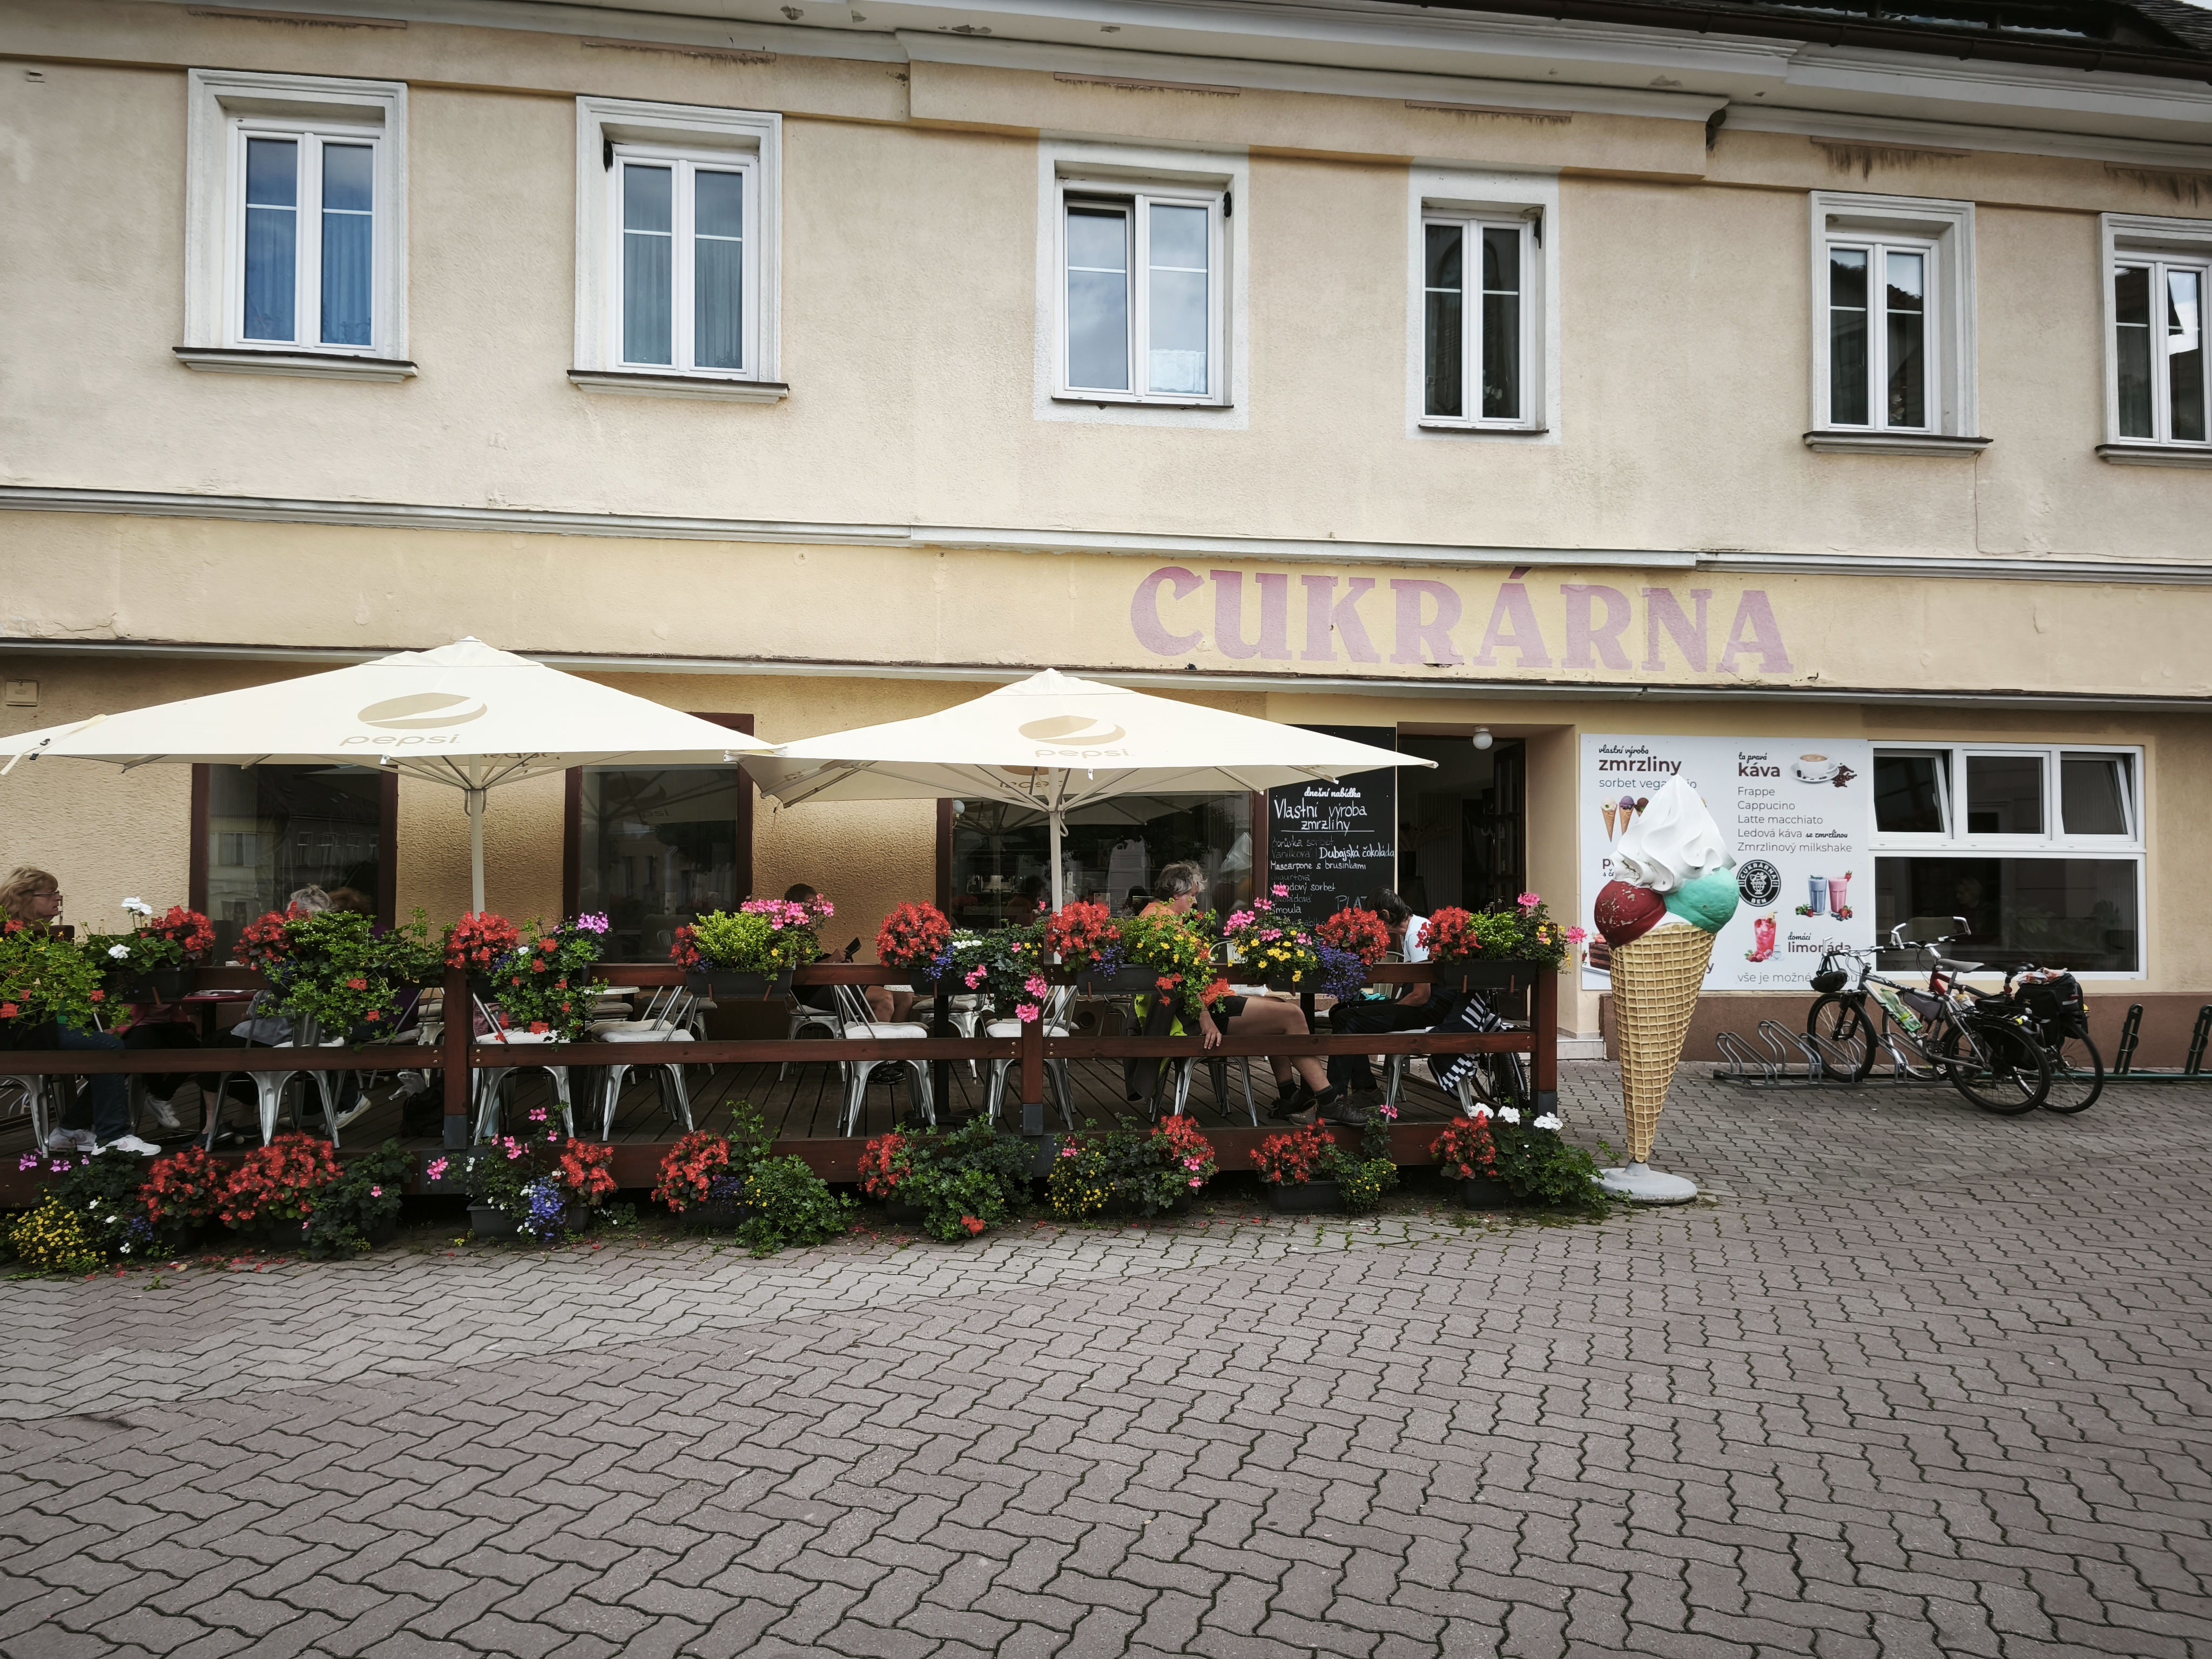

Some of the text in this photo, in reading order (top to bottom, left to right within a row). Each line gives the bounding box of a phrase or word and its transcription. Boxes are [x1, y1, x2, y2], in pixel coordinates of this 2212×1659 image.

[1130, 566, 1794, 674] CUKRÁRNA
[339, 734, 460, 747] pepsi
[1035, 749, 1129, 759] pepsi
[1599, 744, 1649, 758] vlastní výroba
[1738, 752, 1767, 764] ta pravá
[1599, 756, 1682, 776] zmrzliny
[1738, 762, 1780, 777] káva
[1599, 778, 1636, 788] sorbet
[1640, 780, 1667, 791] vega
[1304, 786, 1360, 798] dnešní nabídka
[1738, 786, 1775, 798] Frappe
[1274, 798, 1367, 819] Vlastní výroba
[1737, 800, 1795, 811] Cappucino
[1738, 815, 1823, 824] Latte macchiato
[1301, 817, 1350, 836] zmrzliny
[1738, 828, 1775, 838] Ledová
[1779, 828, 1802, 838] káva
[1815, 829, 1848, 838] zmrzlinou
[1307, 835, 1334, 846] sorbet
[1271, 848, 1313, 859] Vanilková
[1319, 842, 1394, 861] Dubajská čokoláda
[1737, 842, 1852, 854] Zmrzlinový milkshake
[1270, 860, 1313, 872] Mascarpone
[1325, 859, 1366, 870] brusinkami
[1310, 882, 1336, 892] sorbet
[1788, 932, 1811, 940] domácí
[1737, 973, 1811, 984] vše je možné
